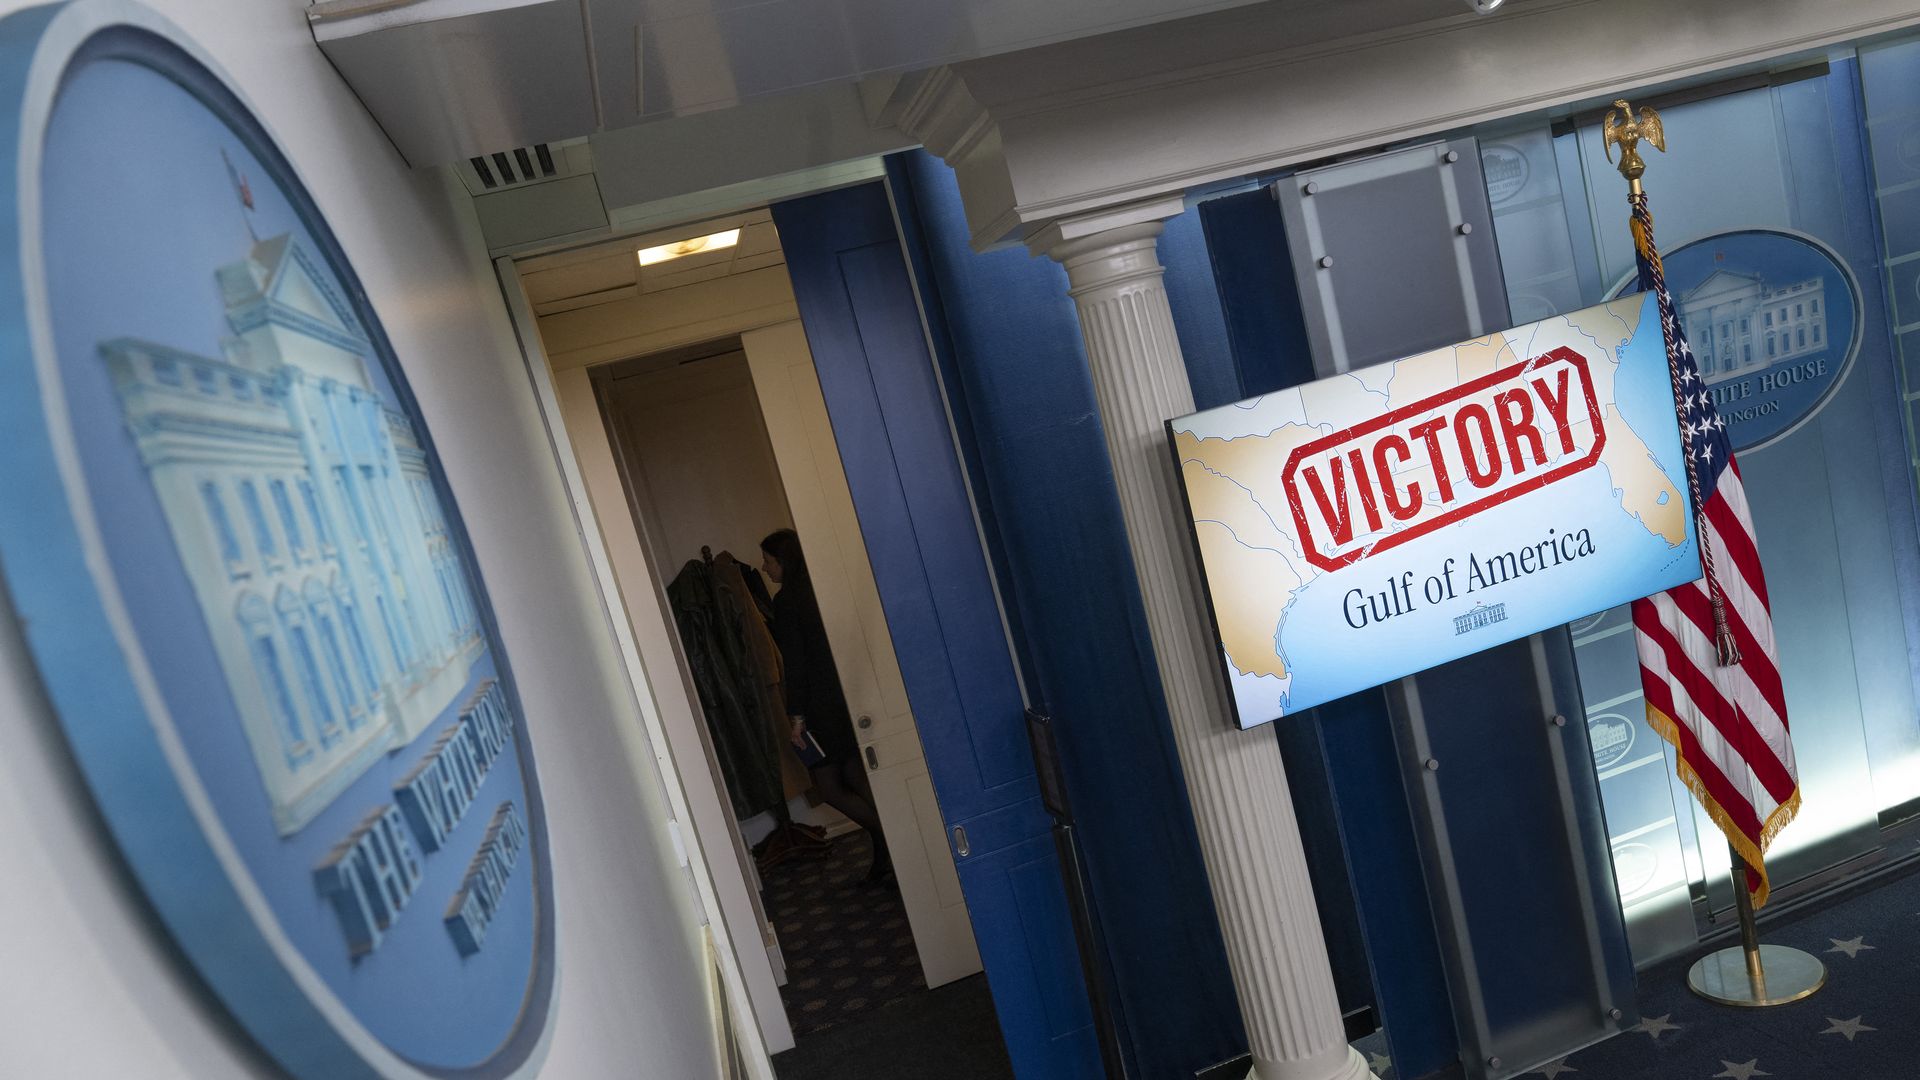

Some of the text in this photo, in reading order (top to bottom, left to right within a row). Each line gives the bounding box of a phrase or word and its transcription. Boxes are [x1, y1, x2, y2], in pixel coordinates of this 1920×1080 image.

[1711, 359, 1828, 406] ITE HOUSE
[1721, 400, 1780, 426] INGTON
[1301, 367, 1576, 546] VICTORY
[1342, 528, 1596, 629] Gulf of America
[326, 677, 514, 954] THE WHITE HOE
